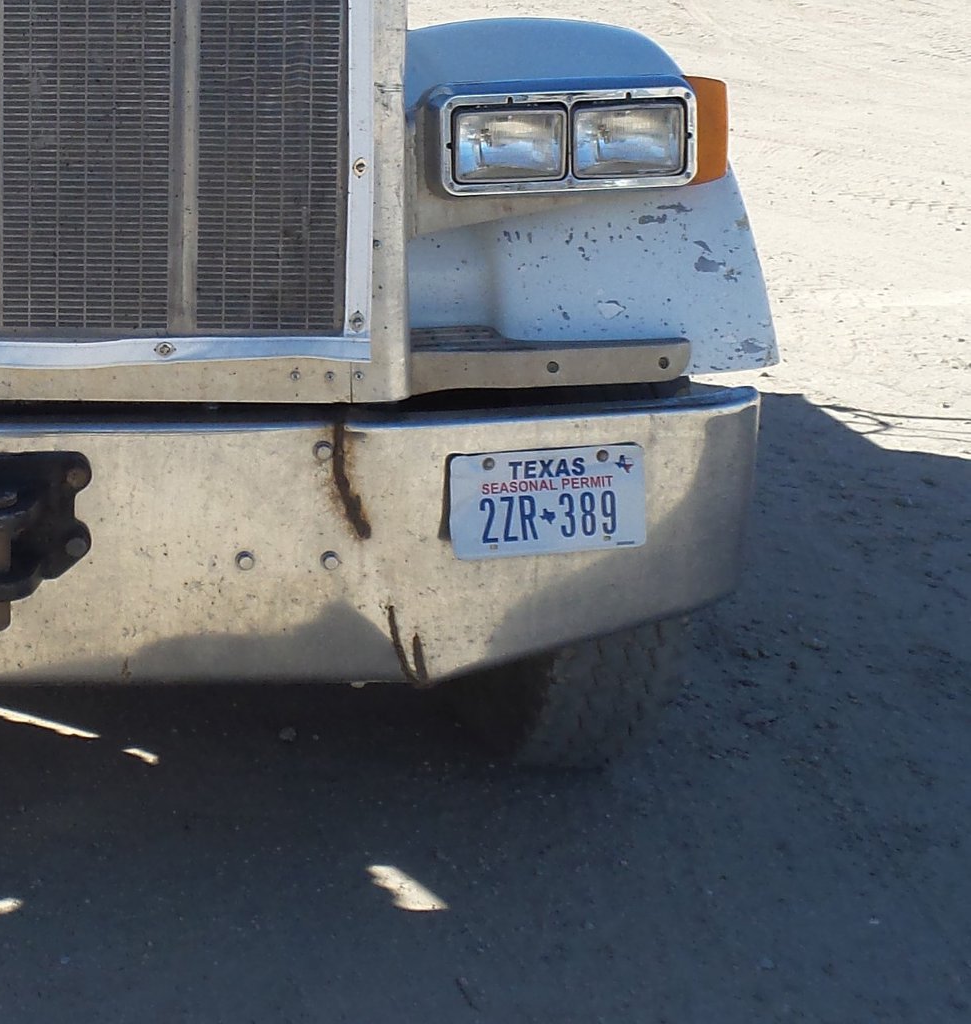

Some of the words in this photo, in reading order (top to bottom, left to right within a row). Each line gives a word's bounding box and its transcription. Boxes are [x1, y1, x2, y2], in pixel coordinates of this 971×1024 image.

[508, 457, 586, 480] TEXAS
[481, 479, 558, 495] SEASONAL
[561, 476, 614, 490] PERMIT
